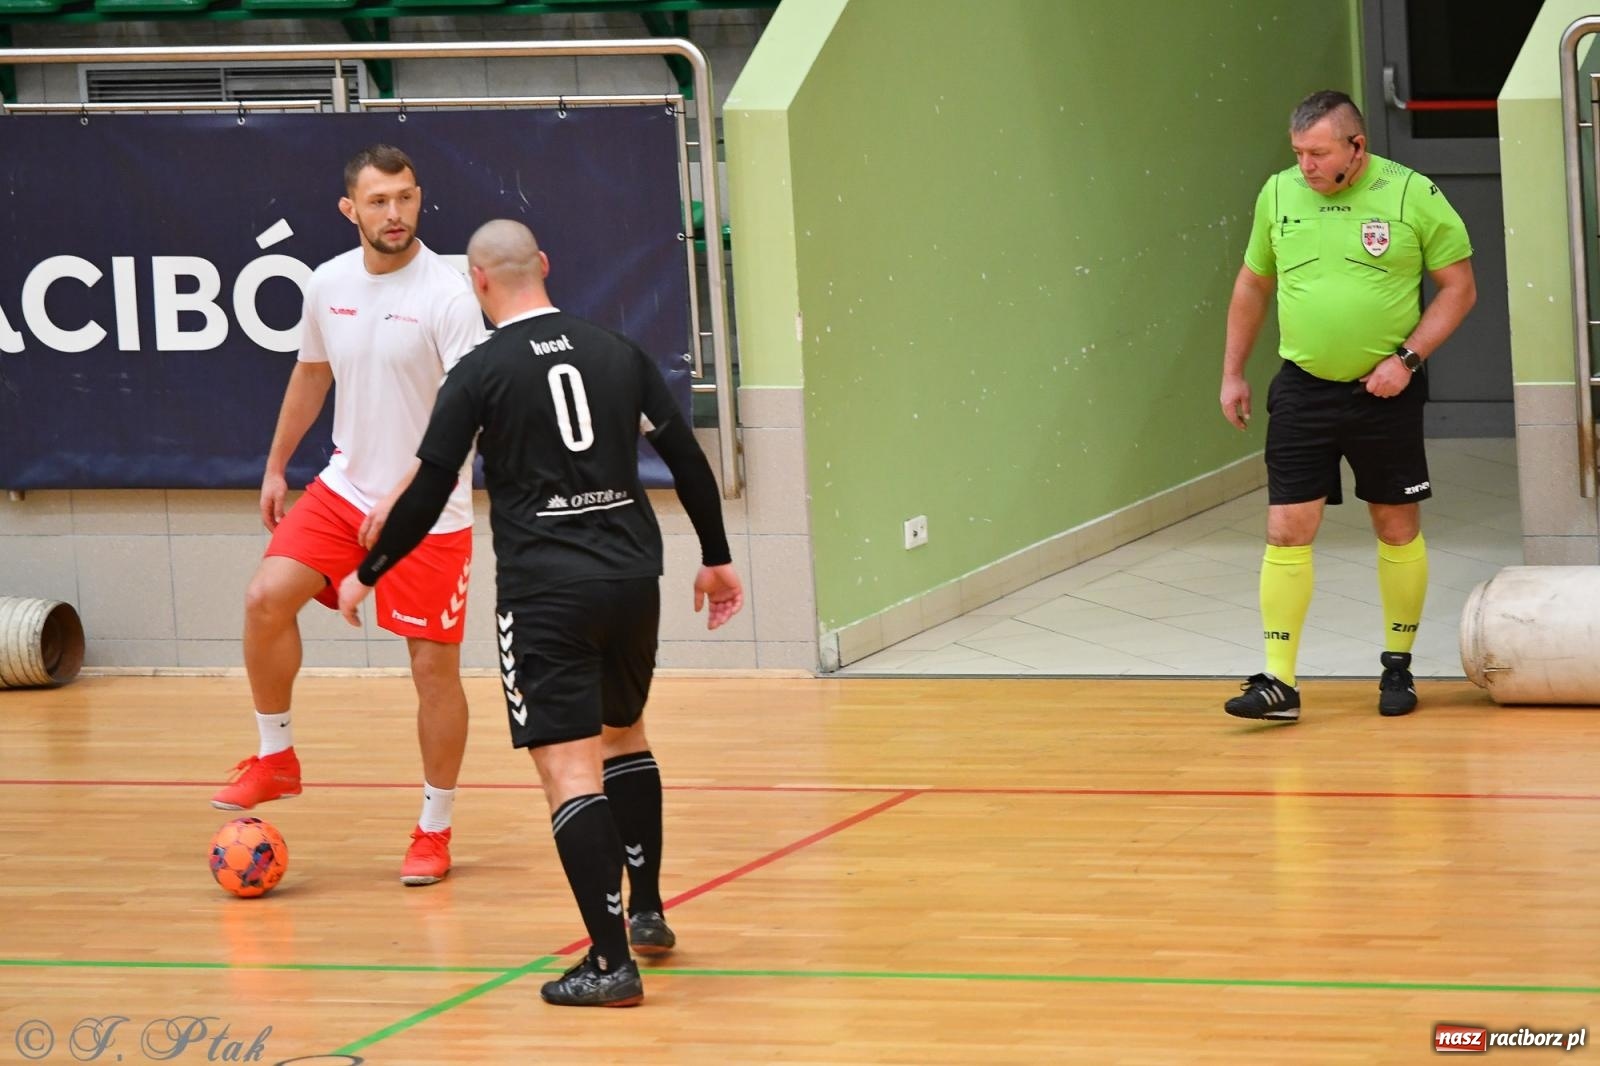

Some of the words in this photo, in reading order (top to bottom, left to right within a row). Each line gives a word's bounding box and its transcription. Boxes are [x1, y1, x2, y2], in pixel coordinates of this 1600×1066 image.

[1319, 204, 1352, 213] zina
[0, 218, 314, 354] CIBÓ
[529, 334, 575, 356] kocot
[547, 363, 595, 452] 0
